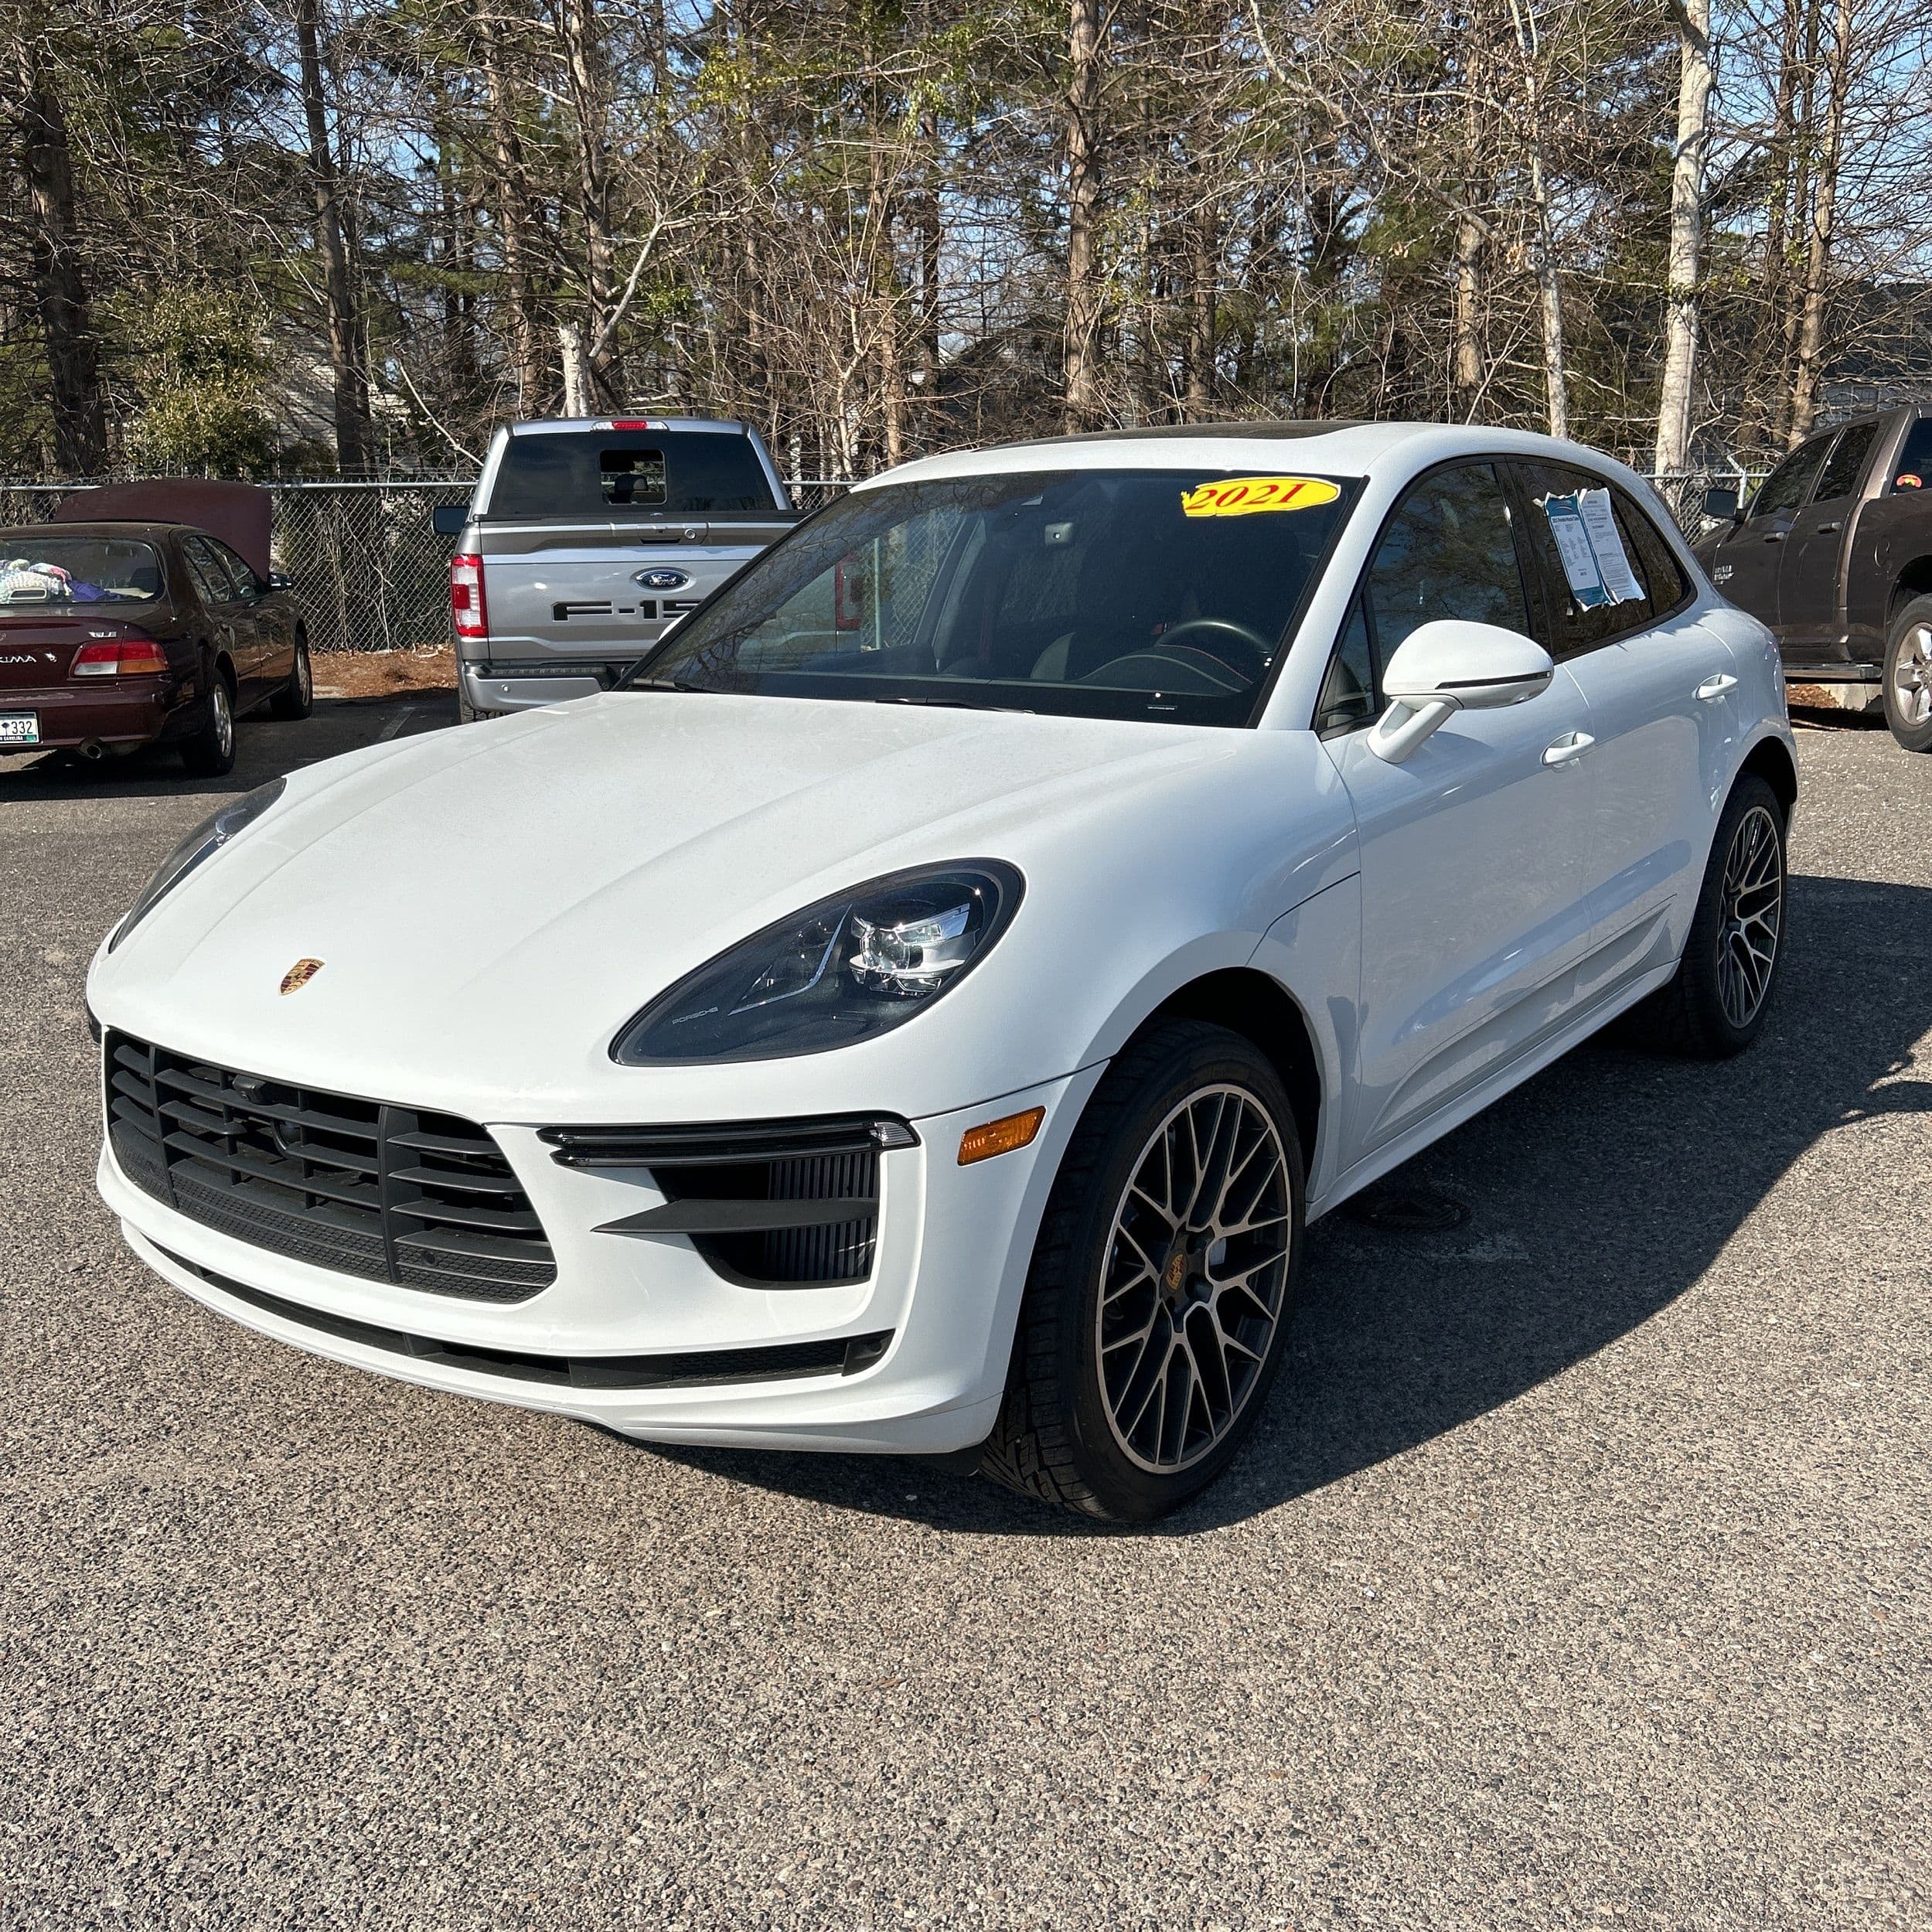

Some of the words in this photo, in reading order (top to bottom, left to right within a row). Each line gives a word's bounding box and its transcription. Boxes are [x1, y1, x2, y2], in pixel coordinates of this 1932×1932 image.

[1184, 483, 1307, 510] 2021
[649, 573, 678, 586] Ford
[552, 600, 704, 622] F-15
[11, 721, 34, 734] 332
[672, 1006, 718, 1025] PORSCHE
